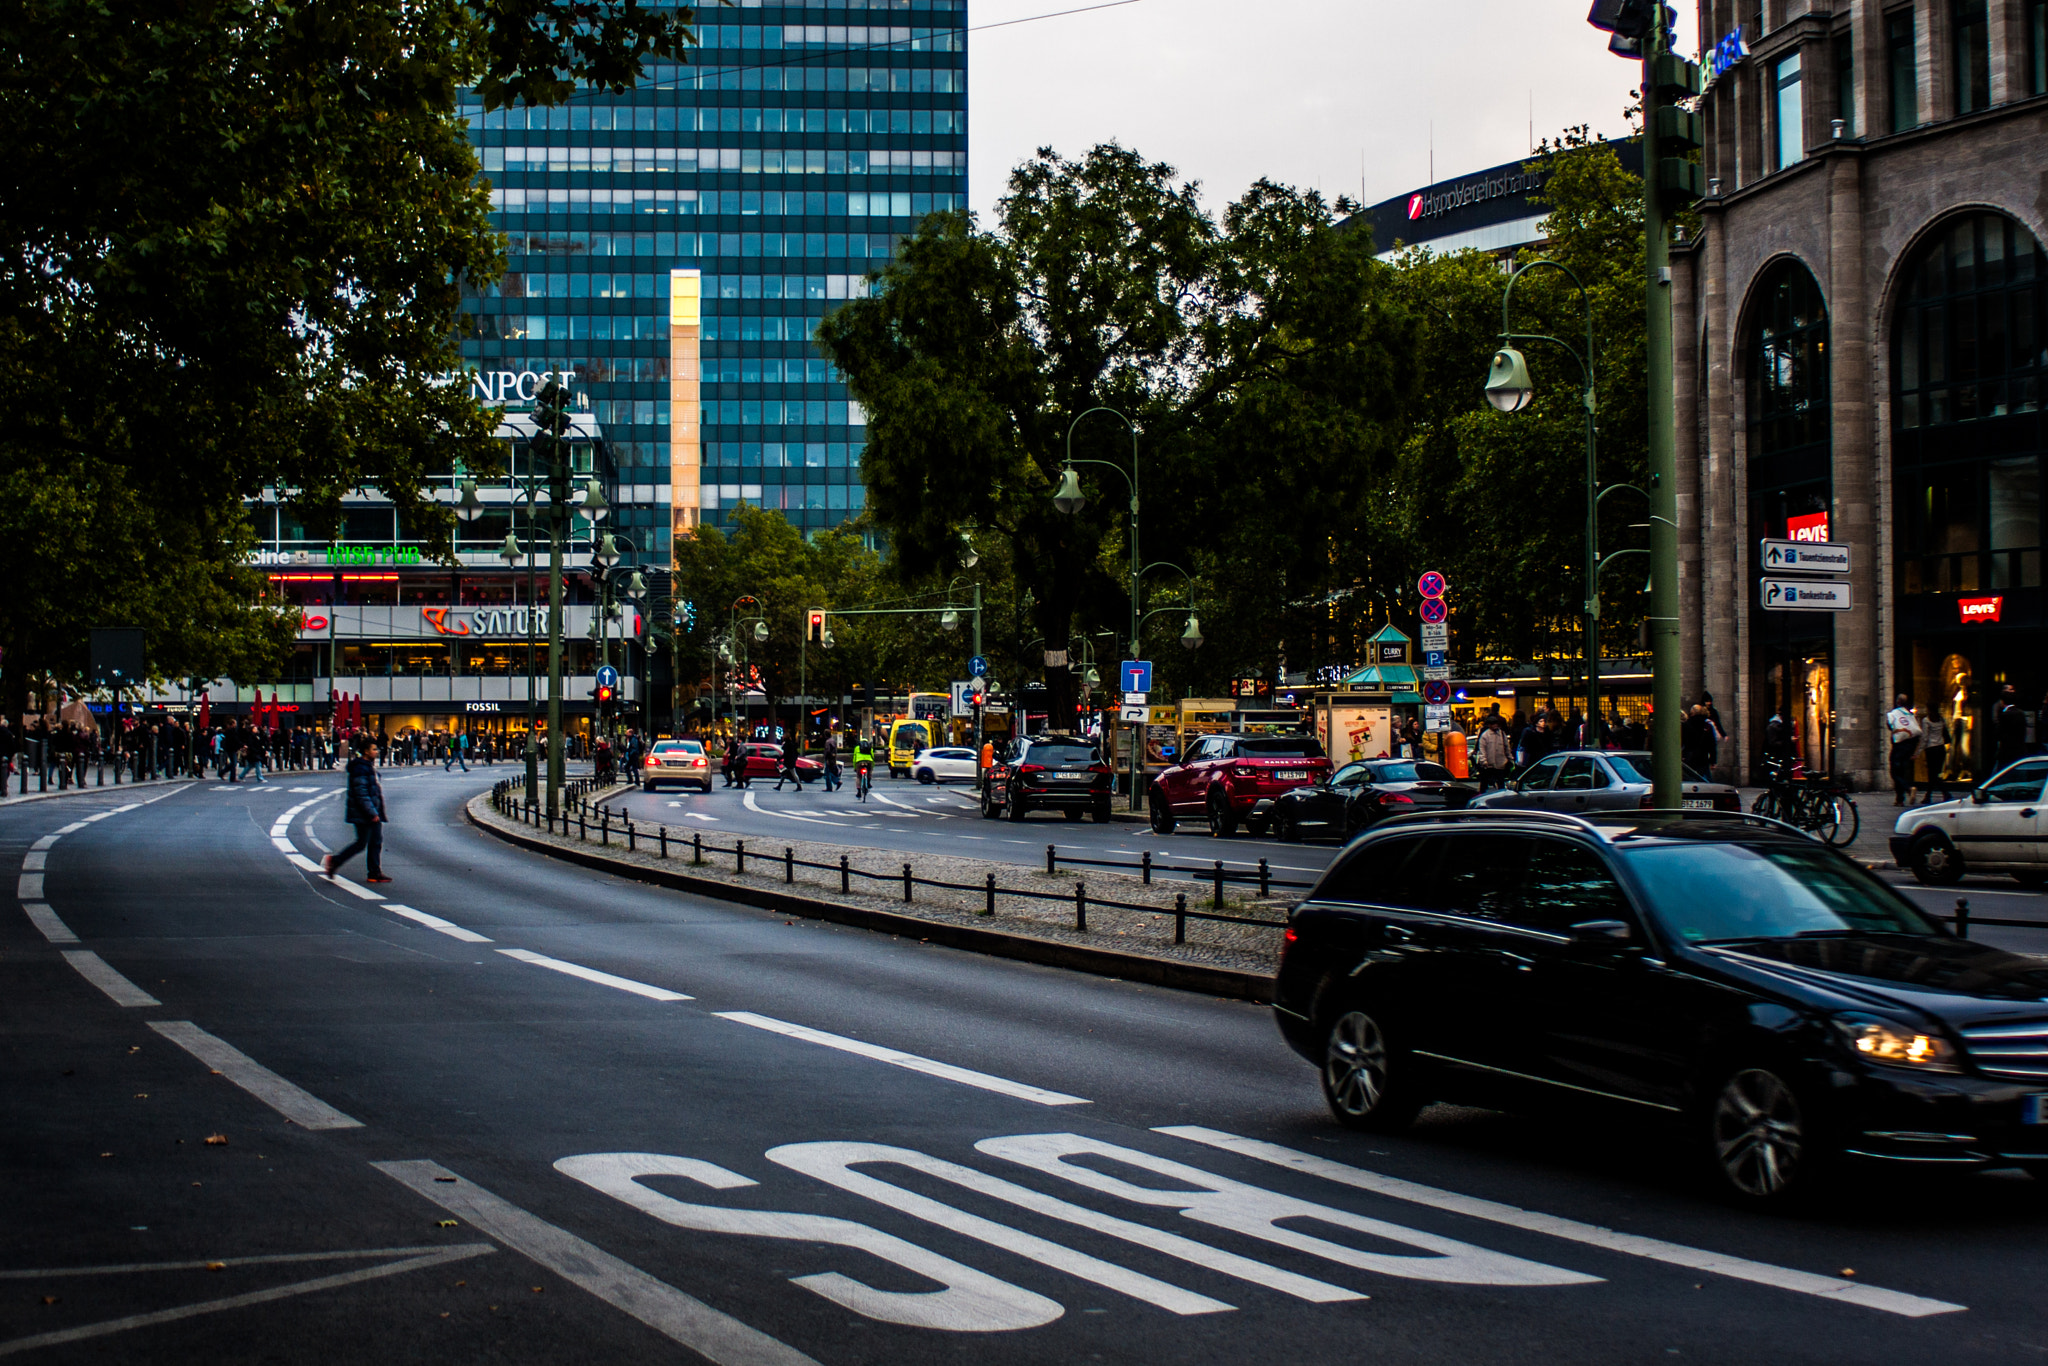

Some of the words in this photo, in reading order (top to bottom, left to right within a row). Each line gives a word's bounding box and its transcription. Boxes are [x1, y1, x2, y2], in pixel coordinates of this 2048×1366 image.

[1422, 170, 1542, 218] HypoVereinsbank
[326, 546, 376, 566] IRISH
[381, 546, 420, 564] PUB
[466, 702, 501, 712] FOSSIL
